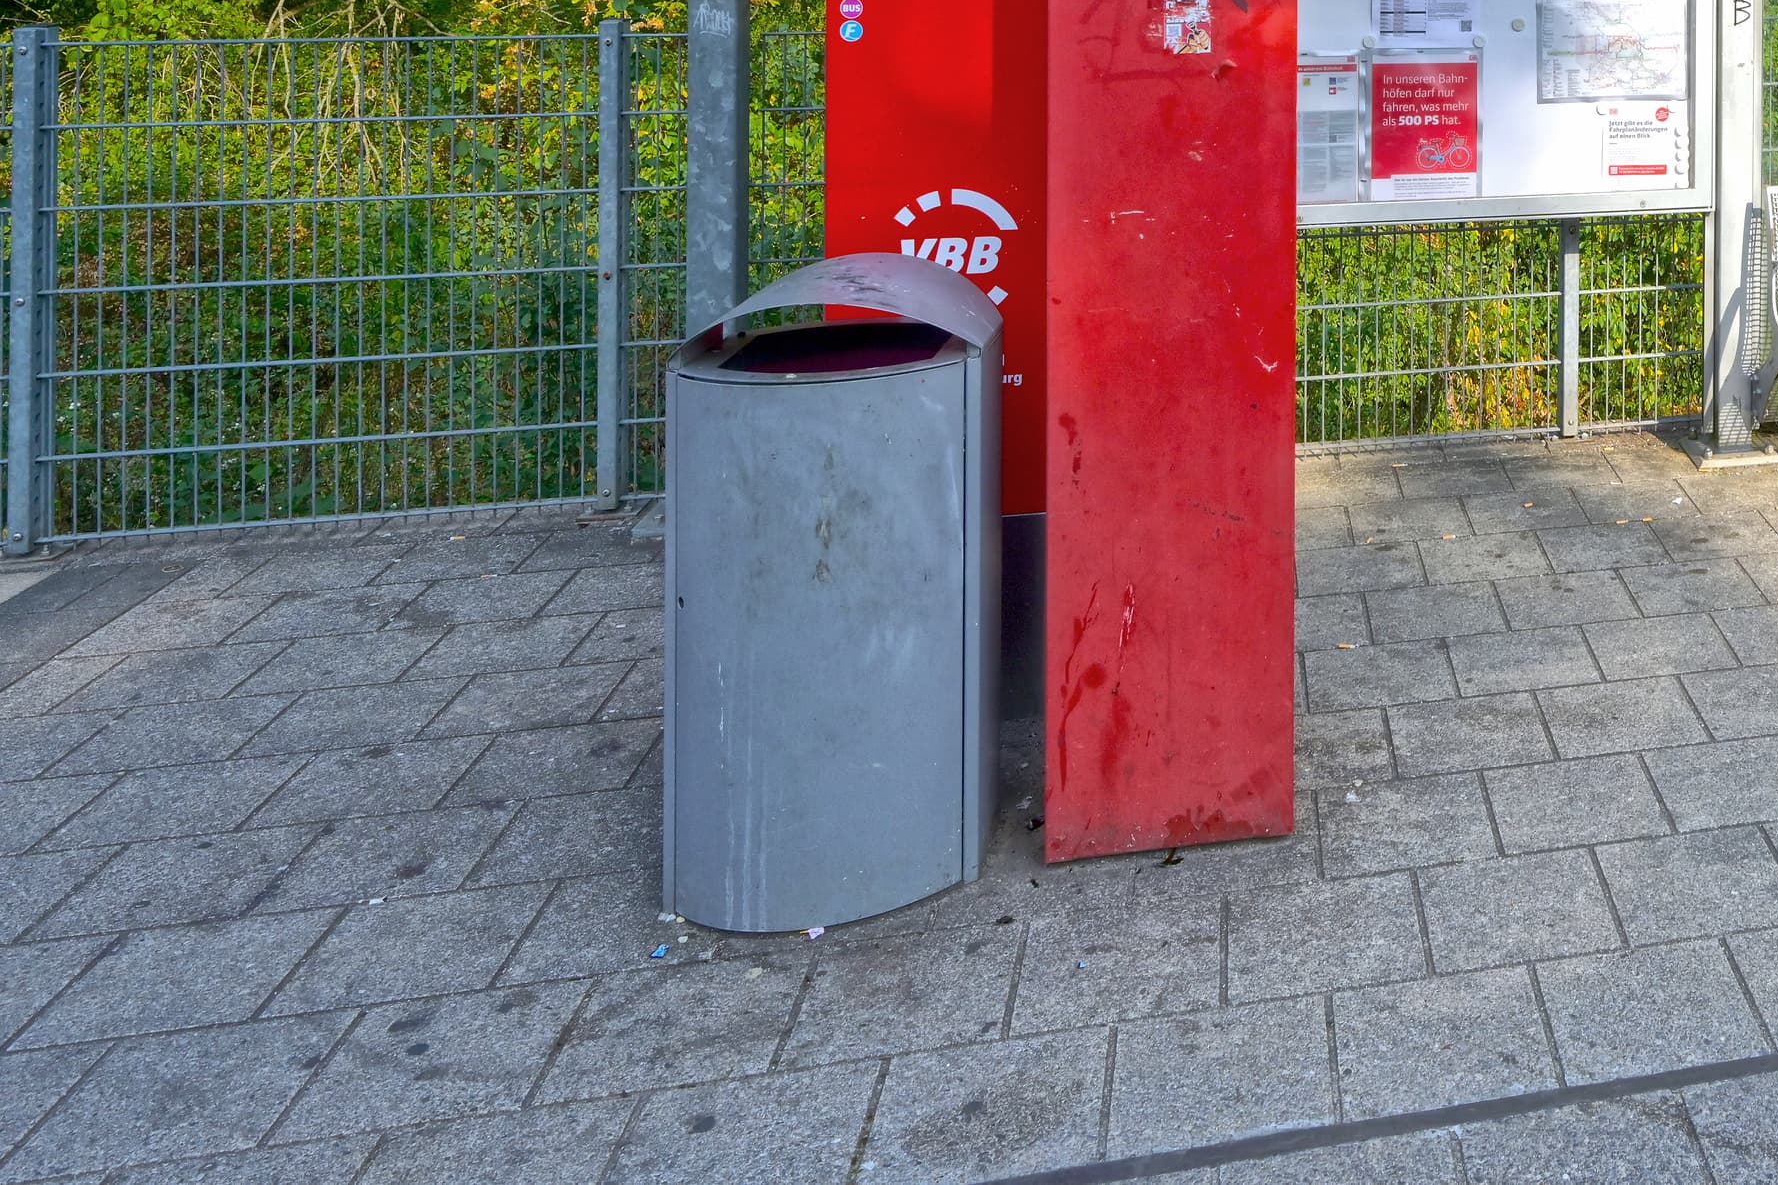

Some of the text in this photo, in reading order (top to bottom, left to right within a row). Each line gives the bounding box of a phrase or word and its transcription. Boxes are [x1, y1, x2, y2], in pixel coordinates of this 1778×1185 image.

[842, 4, 861, 13] BUS
[1383, 73, 1468, 84] In unseren Bahn-
[1382, 87, 1455, 98] höfen darf nur
[1382, 101, 1469, 113] fahren, was mehr
[1382, 114, 1461, 127] als 500 PS hat.
